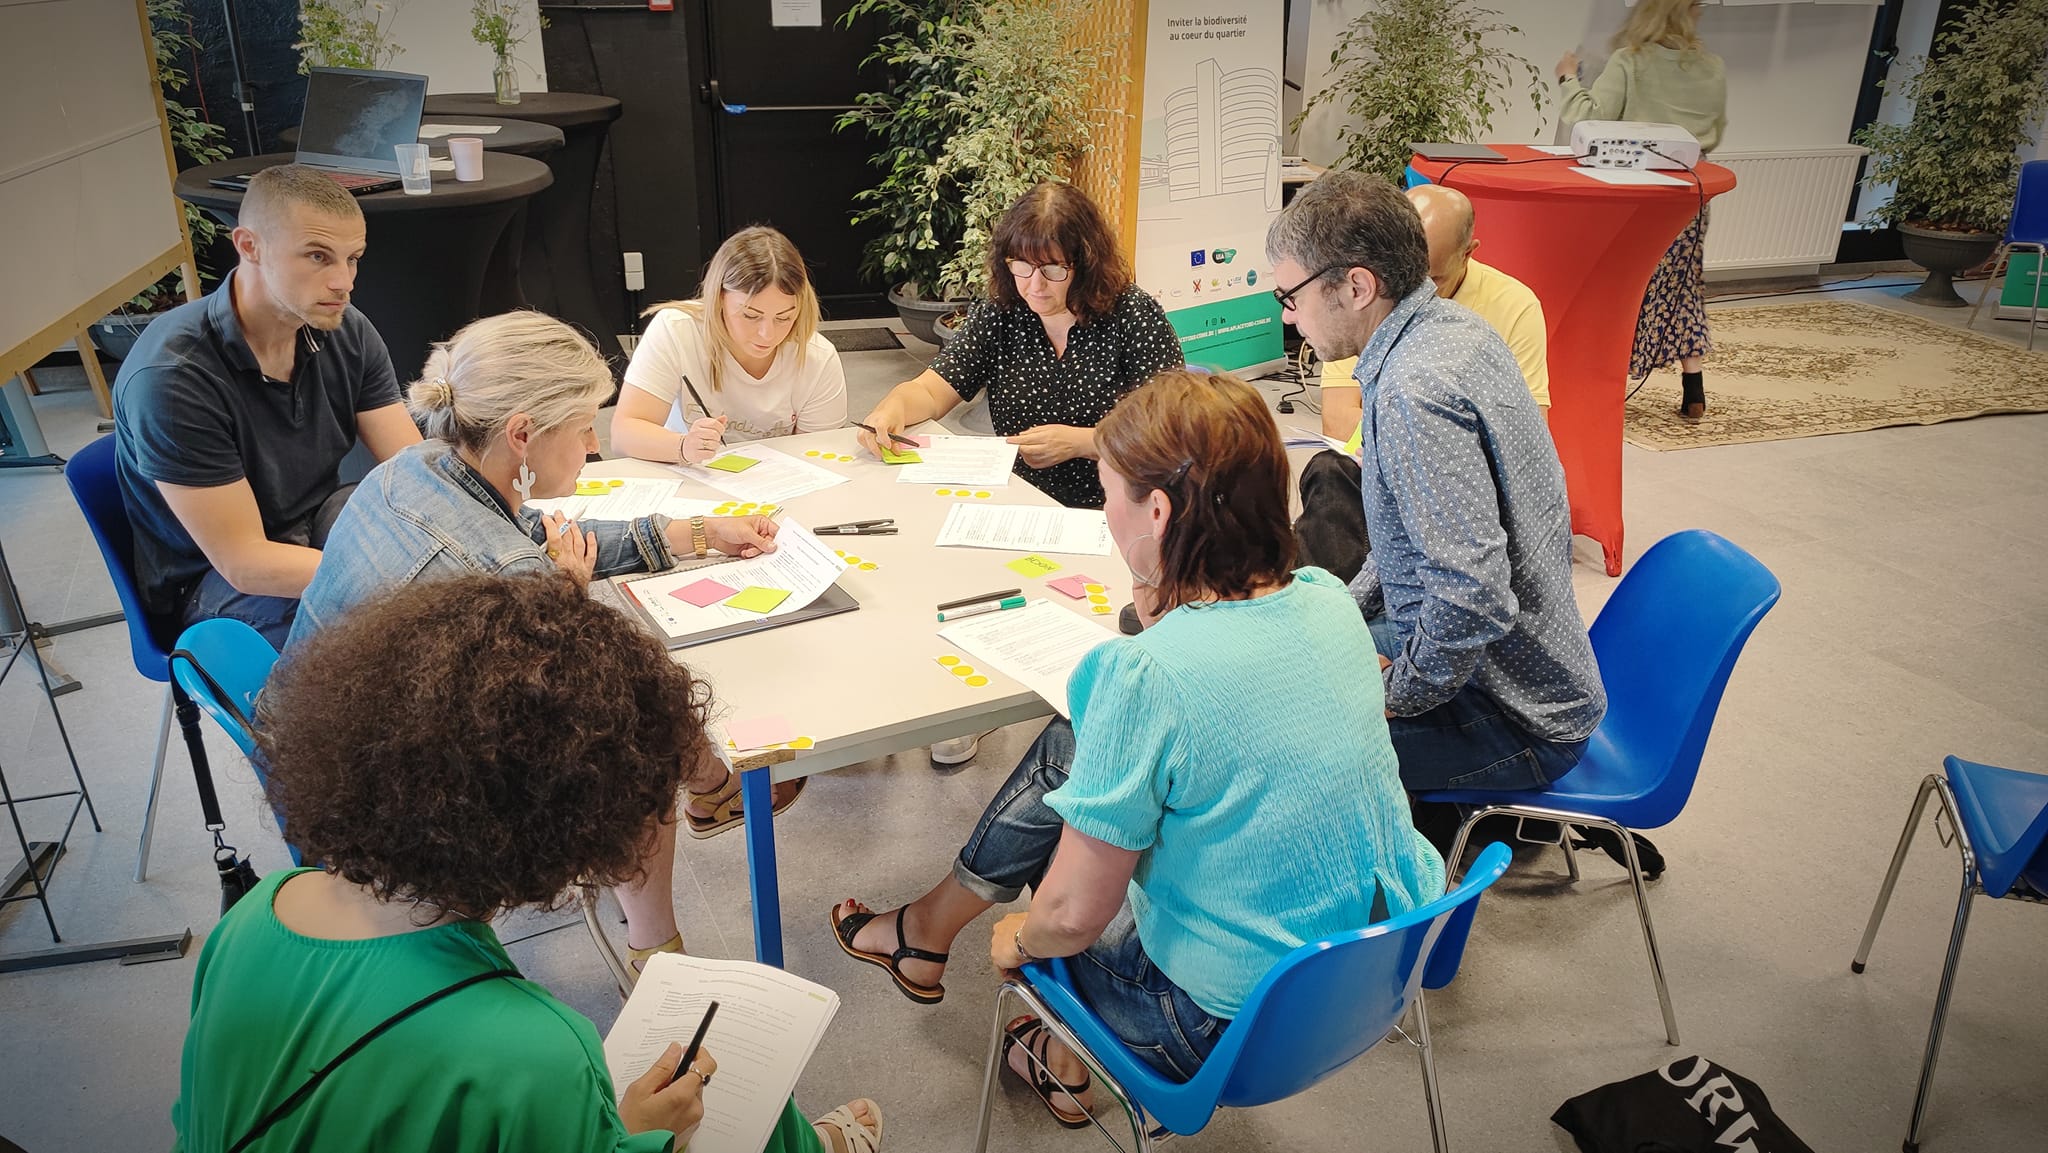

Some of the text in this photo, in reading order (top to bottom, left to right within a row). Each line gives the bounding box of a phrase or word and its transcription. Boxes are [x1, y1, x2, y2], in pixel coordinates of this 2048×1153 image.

[1167, 15, 1248, 27] Inviter la biodiversité
[1169, 28, 1246, 41] au coeur du quartier
